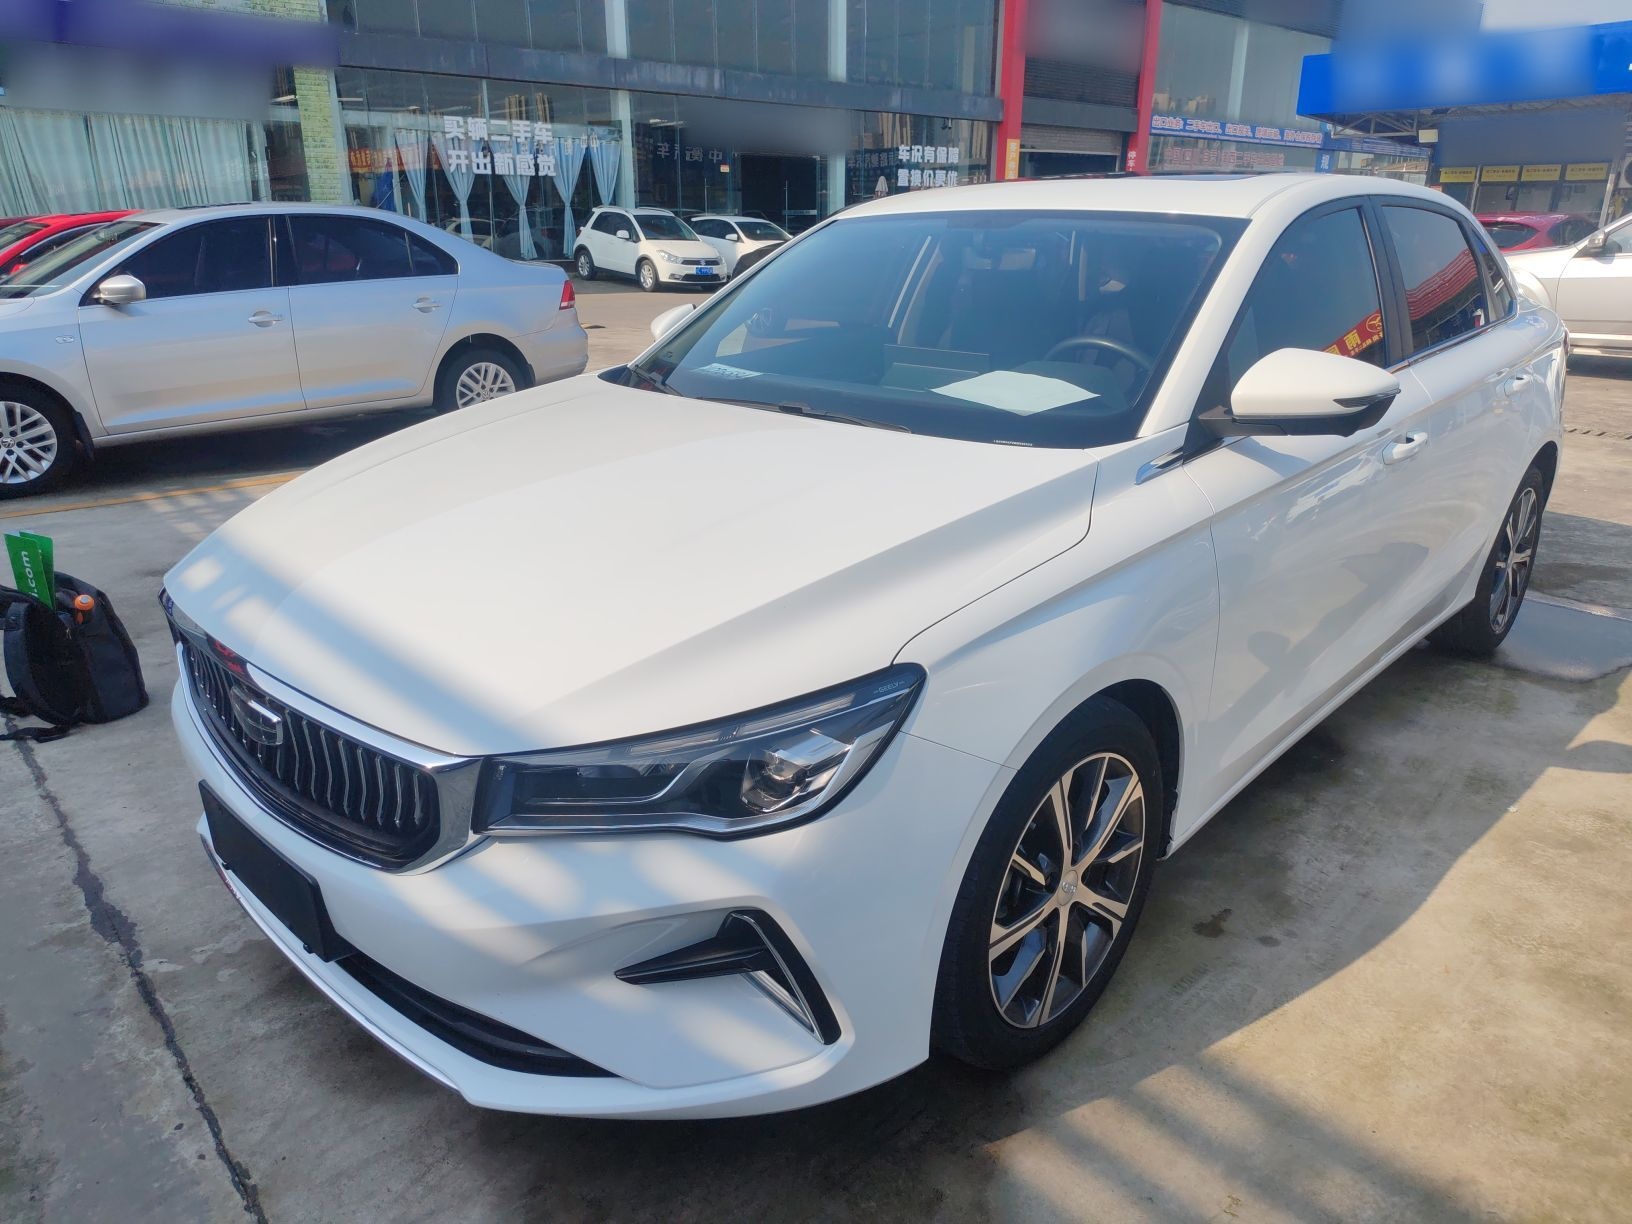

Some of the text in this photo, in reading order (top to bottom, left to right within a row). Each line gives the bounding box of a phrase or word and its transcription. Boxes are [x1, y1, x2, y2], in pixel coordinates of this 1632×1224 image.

[444, 115, 553, 143] 买辆二手车
[448, 150, 557, 176] 开出新感觉
[898, 144, 960, 164] 车况有保障
[897, 168, 958, 188] 置换价更优
